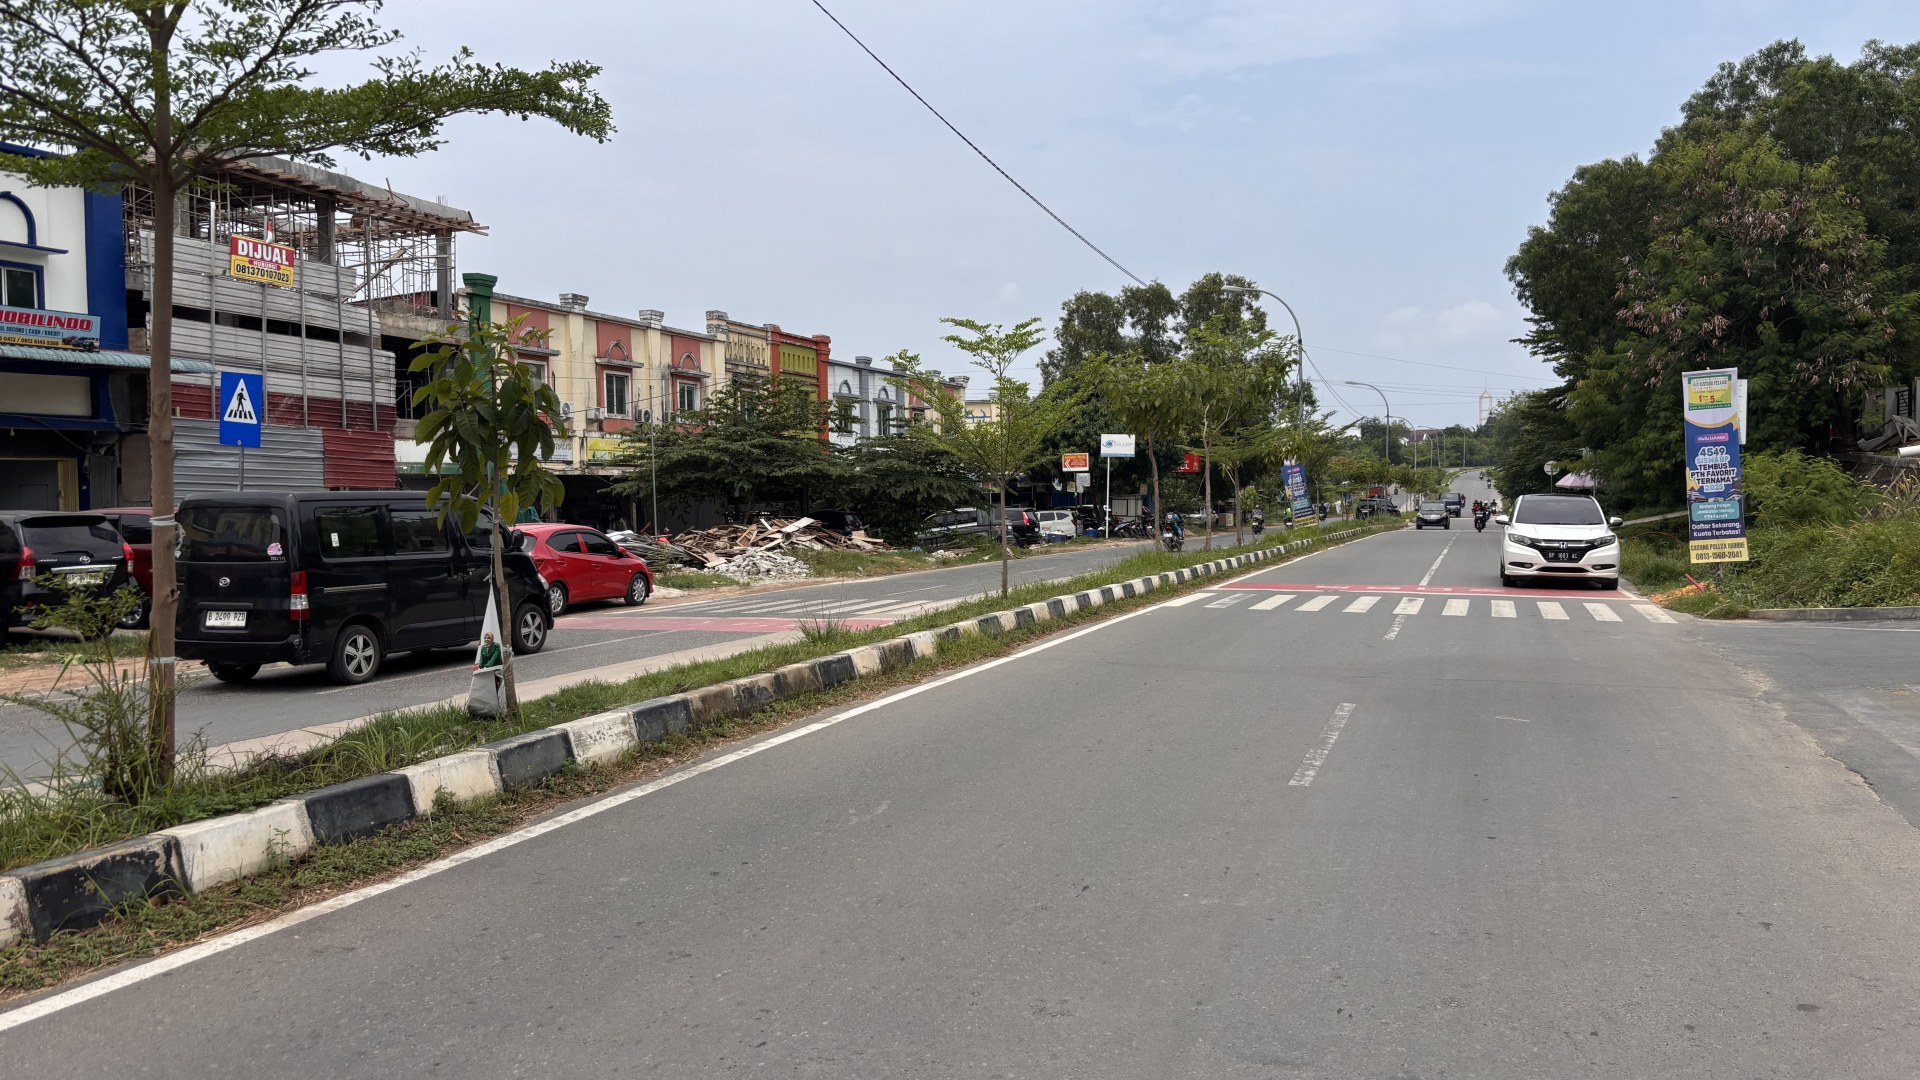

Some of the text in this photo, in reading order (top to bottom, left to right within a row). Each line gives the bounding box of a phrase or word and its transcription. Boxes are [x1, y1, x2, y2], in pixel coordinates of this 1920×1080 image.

[238, 239, 289, 265] DIJUAL
[253, 260, 278, 270] HUBUNGI
[236, 264, 290, 282] 081370107023
[1699, 446, 1726, 456] 4549
[1696, 456, 1719, 464] SISWA
[1698, 463, 1728, 471] TEMBUS
[1691, 469, 1736, 479] PTN FAVORIT
[1696, 477, 1731, 485] TERNAMA
[1704, 484, 1724, 492] 2025
[1712, 528, 1741, 536] Terbatas!
[208, 612, 213, 621] B
